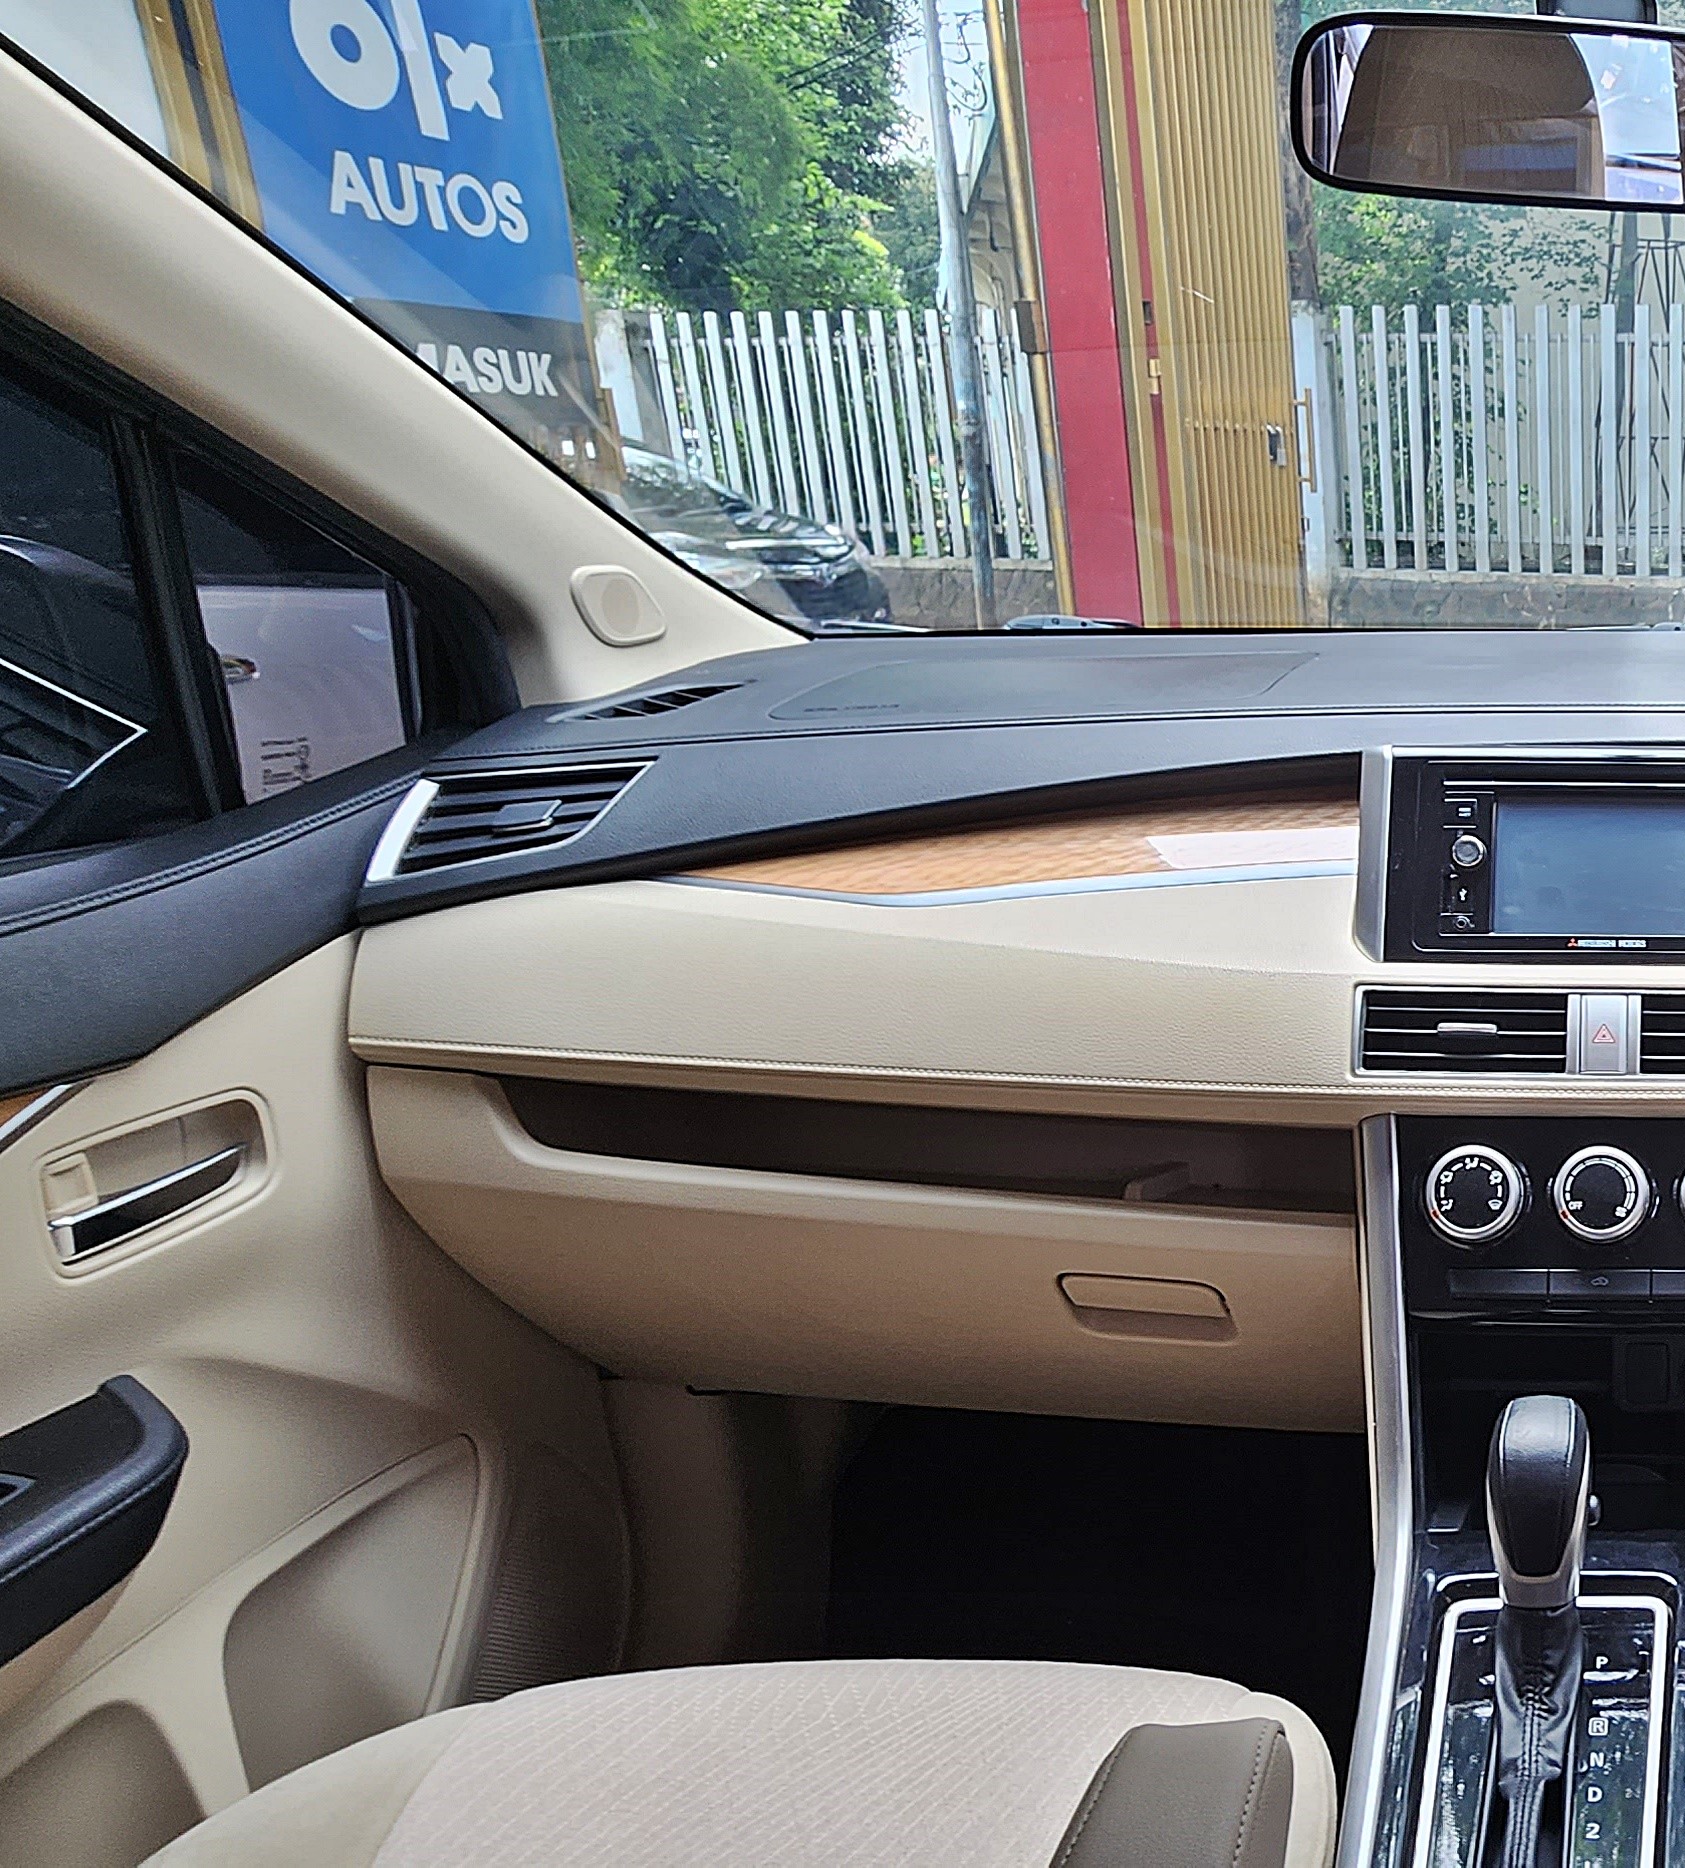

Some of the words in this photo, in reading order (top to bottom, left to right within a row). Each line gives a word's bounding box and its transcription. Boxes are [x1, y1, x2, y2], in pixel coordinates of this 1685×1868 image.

[288, 0, 503, 141] olx
[330, 150, 529, 244] AUTOS
[1568, 1201, 1583, 1211] OFF
[1595, 1656, 1609, 1669] P
[1589, 1752, 1605, 1768] N
[1587, 1787, 1603, 1802] D
[1585, 1823, 1600, 1839] 2
